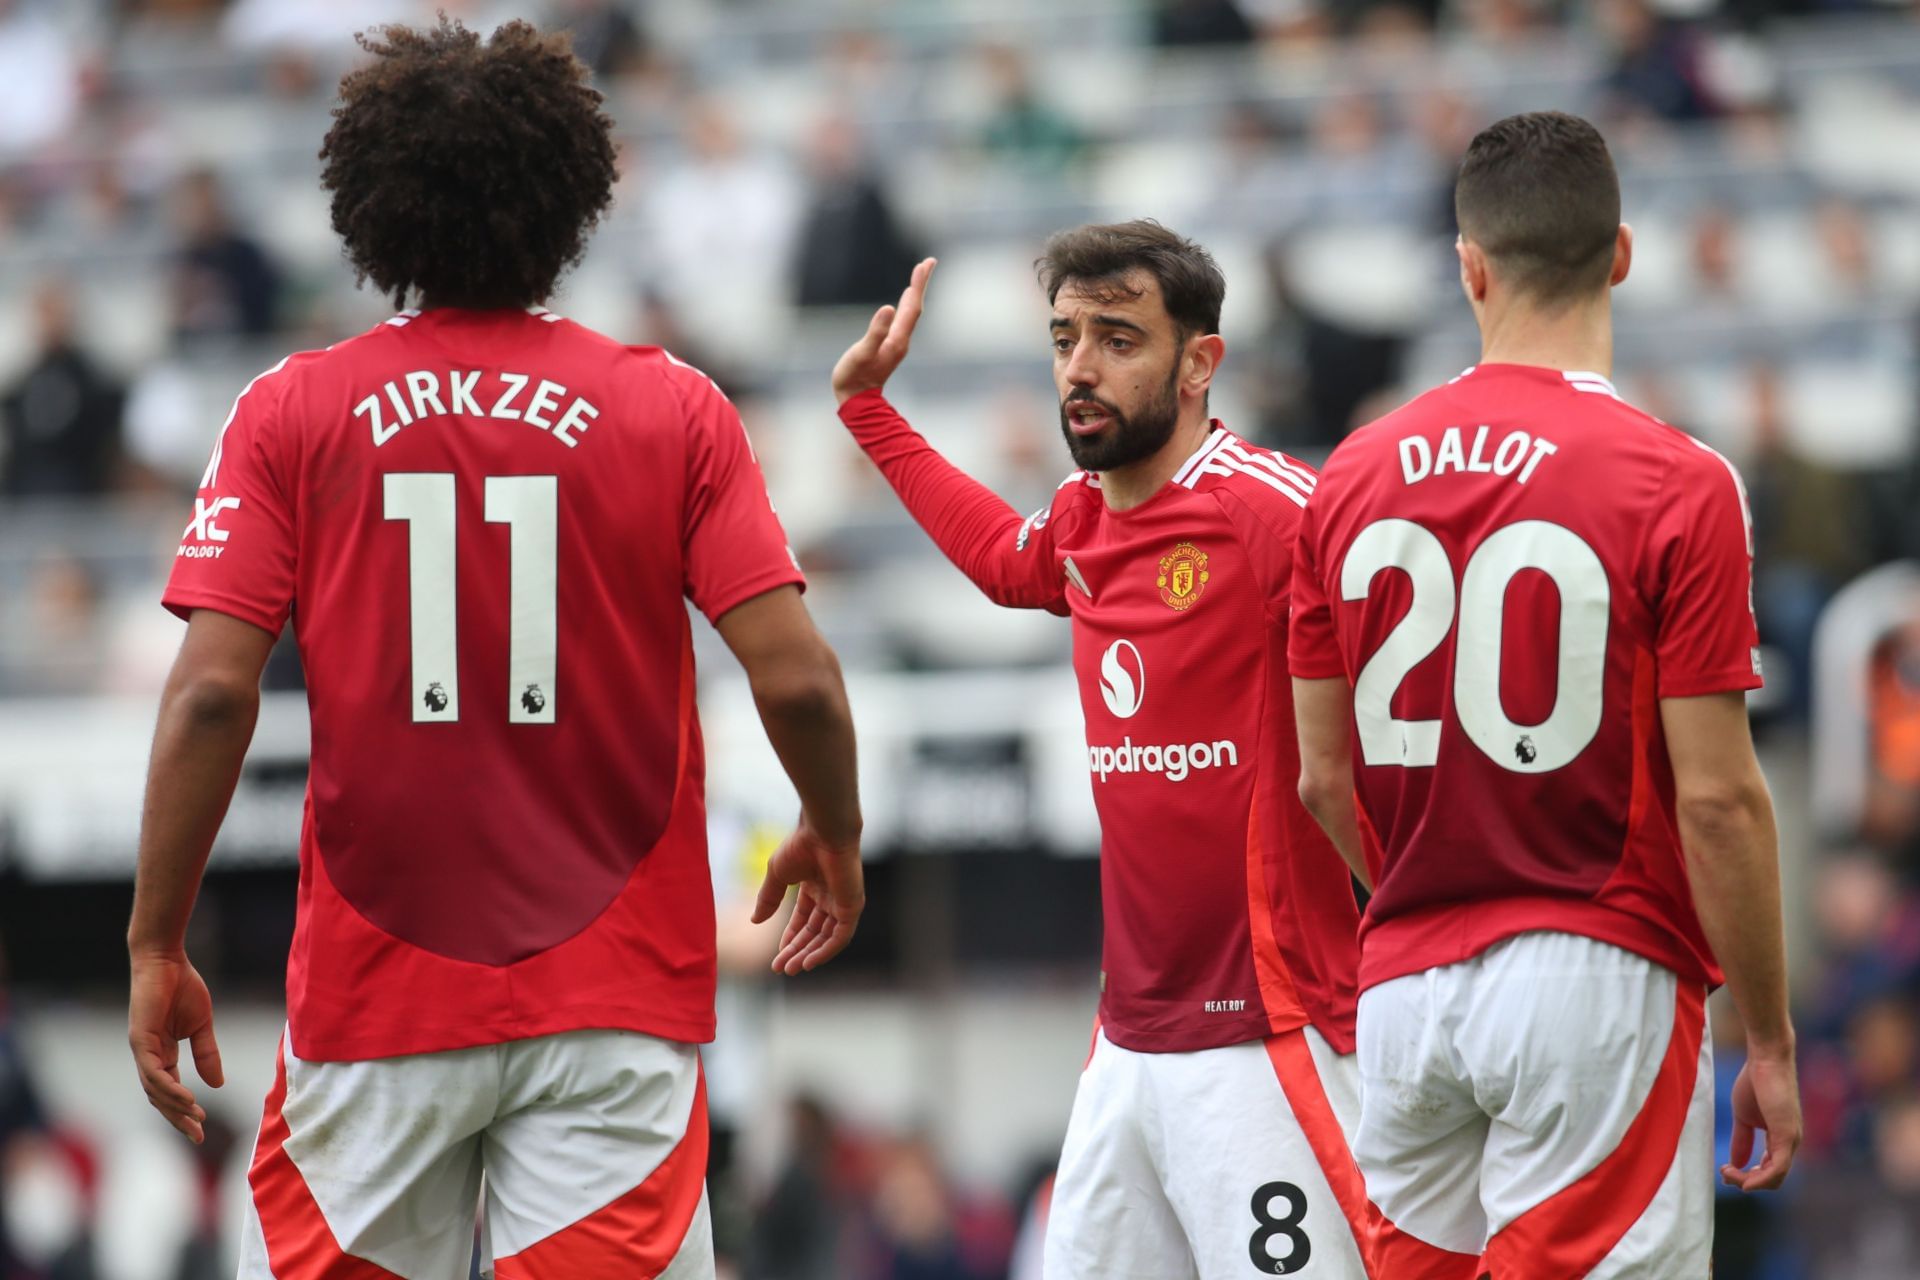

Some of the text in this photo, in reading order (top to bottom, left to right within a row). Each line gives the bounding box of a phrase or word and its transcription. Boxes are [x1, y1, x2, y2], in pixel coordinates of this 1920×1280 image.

[353, 370, 599, 447] ZIRKZEE
[1399, 425, 1558, 485] DALOT
[383, 472, 558, 724] 11
[1168, 592, 1197, 606] UNITED
[1341, 518, 1610, 774] 20
[1248, 1181, 1311, 1275] 8
